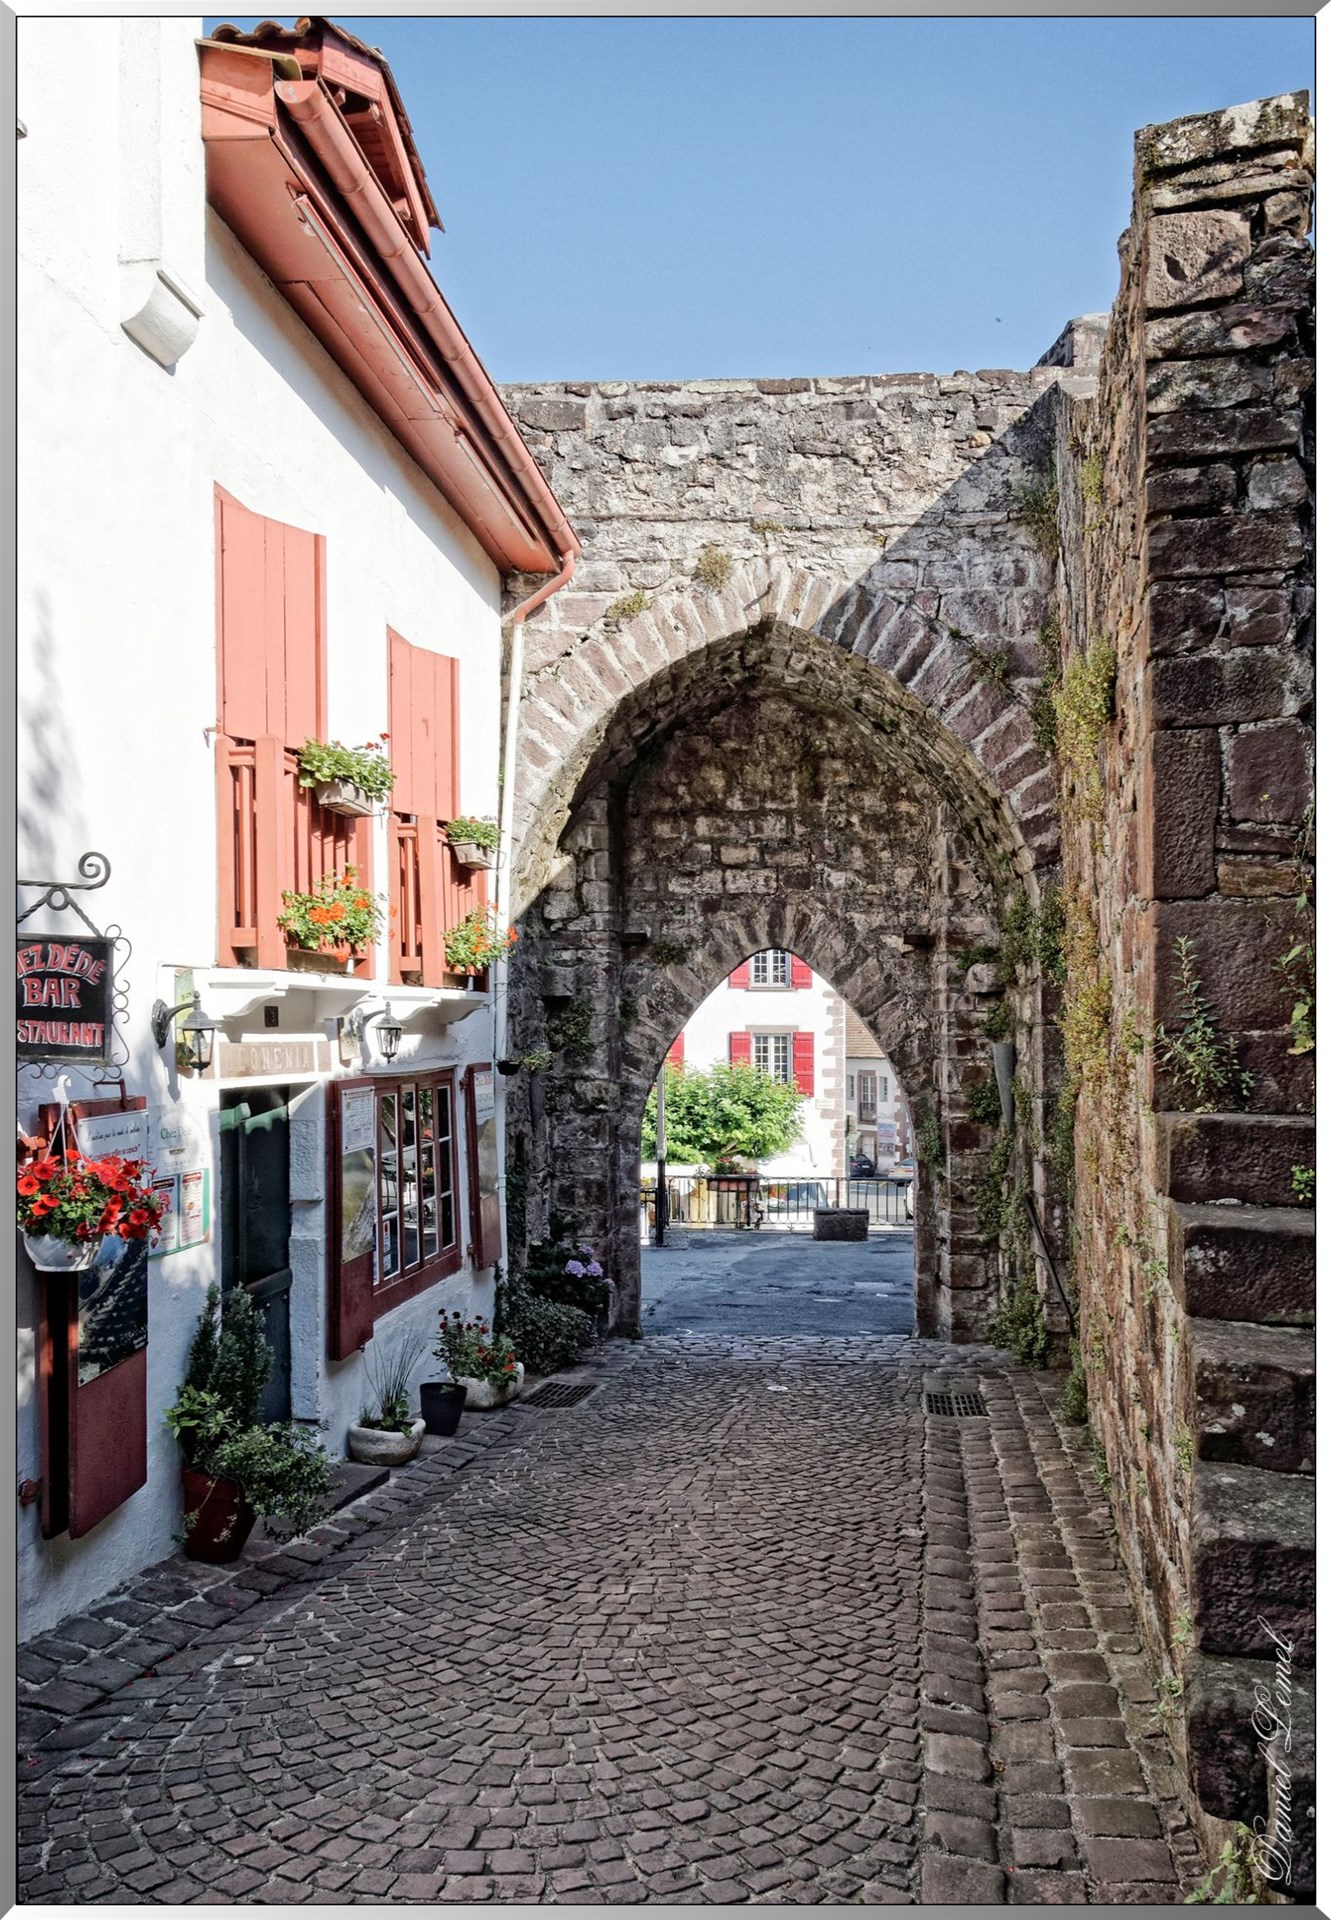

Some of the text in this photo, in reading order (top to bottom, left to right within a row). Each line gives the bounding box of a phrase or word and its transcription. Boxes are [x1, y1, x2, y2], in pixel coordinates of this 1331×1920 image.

[17, 944, 46, 979] EZ
[22, 978, 82, 1008] BAR
[17, 1020, 105, 1047] STAURANT
